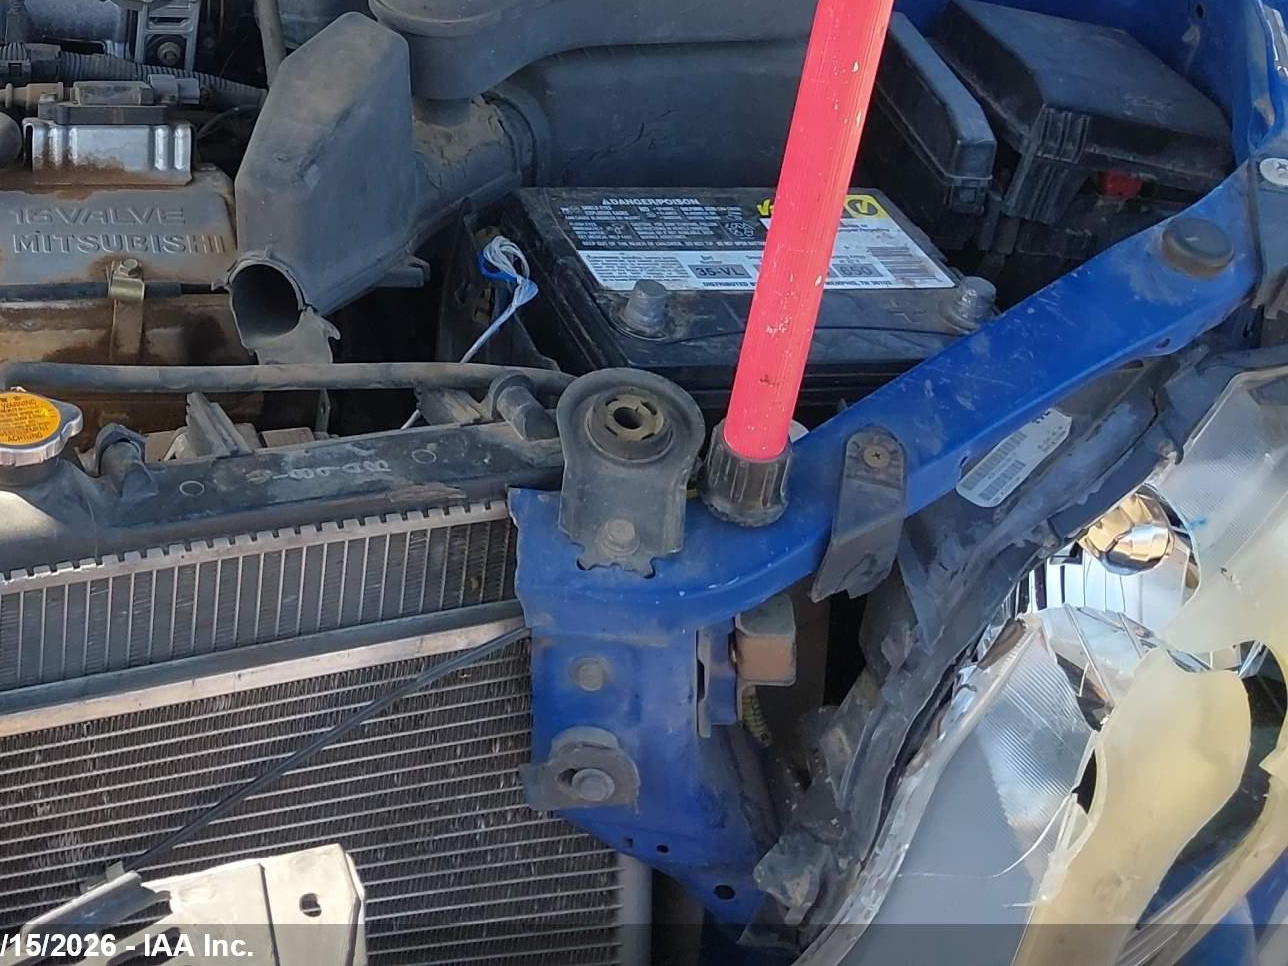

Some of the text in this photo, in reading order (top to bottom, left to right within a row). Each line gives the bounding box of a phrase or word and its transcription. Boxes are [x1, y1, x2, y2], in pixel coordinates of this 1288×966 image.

[12, 233, 227, 254] MITSUBISHI
[695, 267, 745, 276] 35-VL
[839, 266, 873, 276] 650
